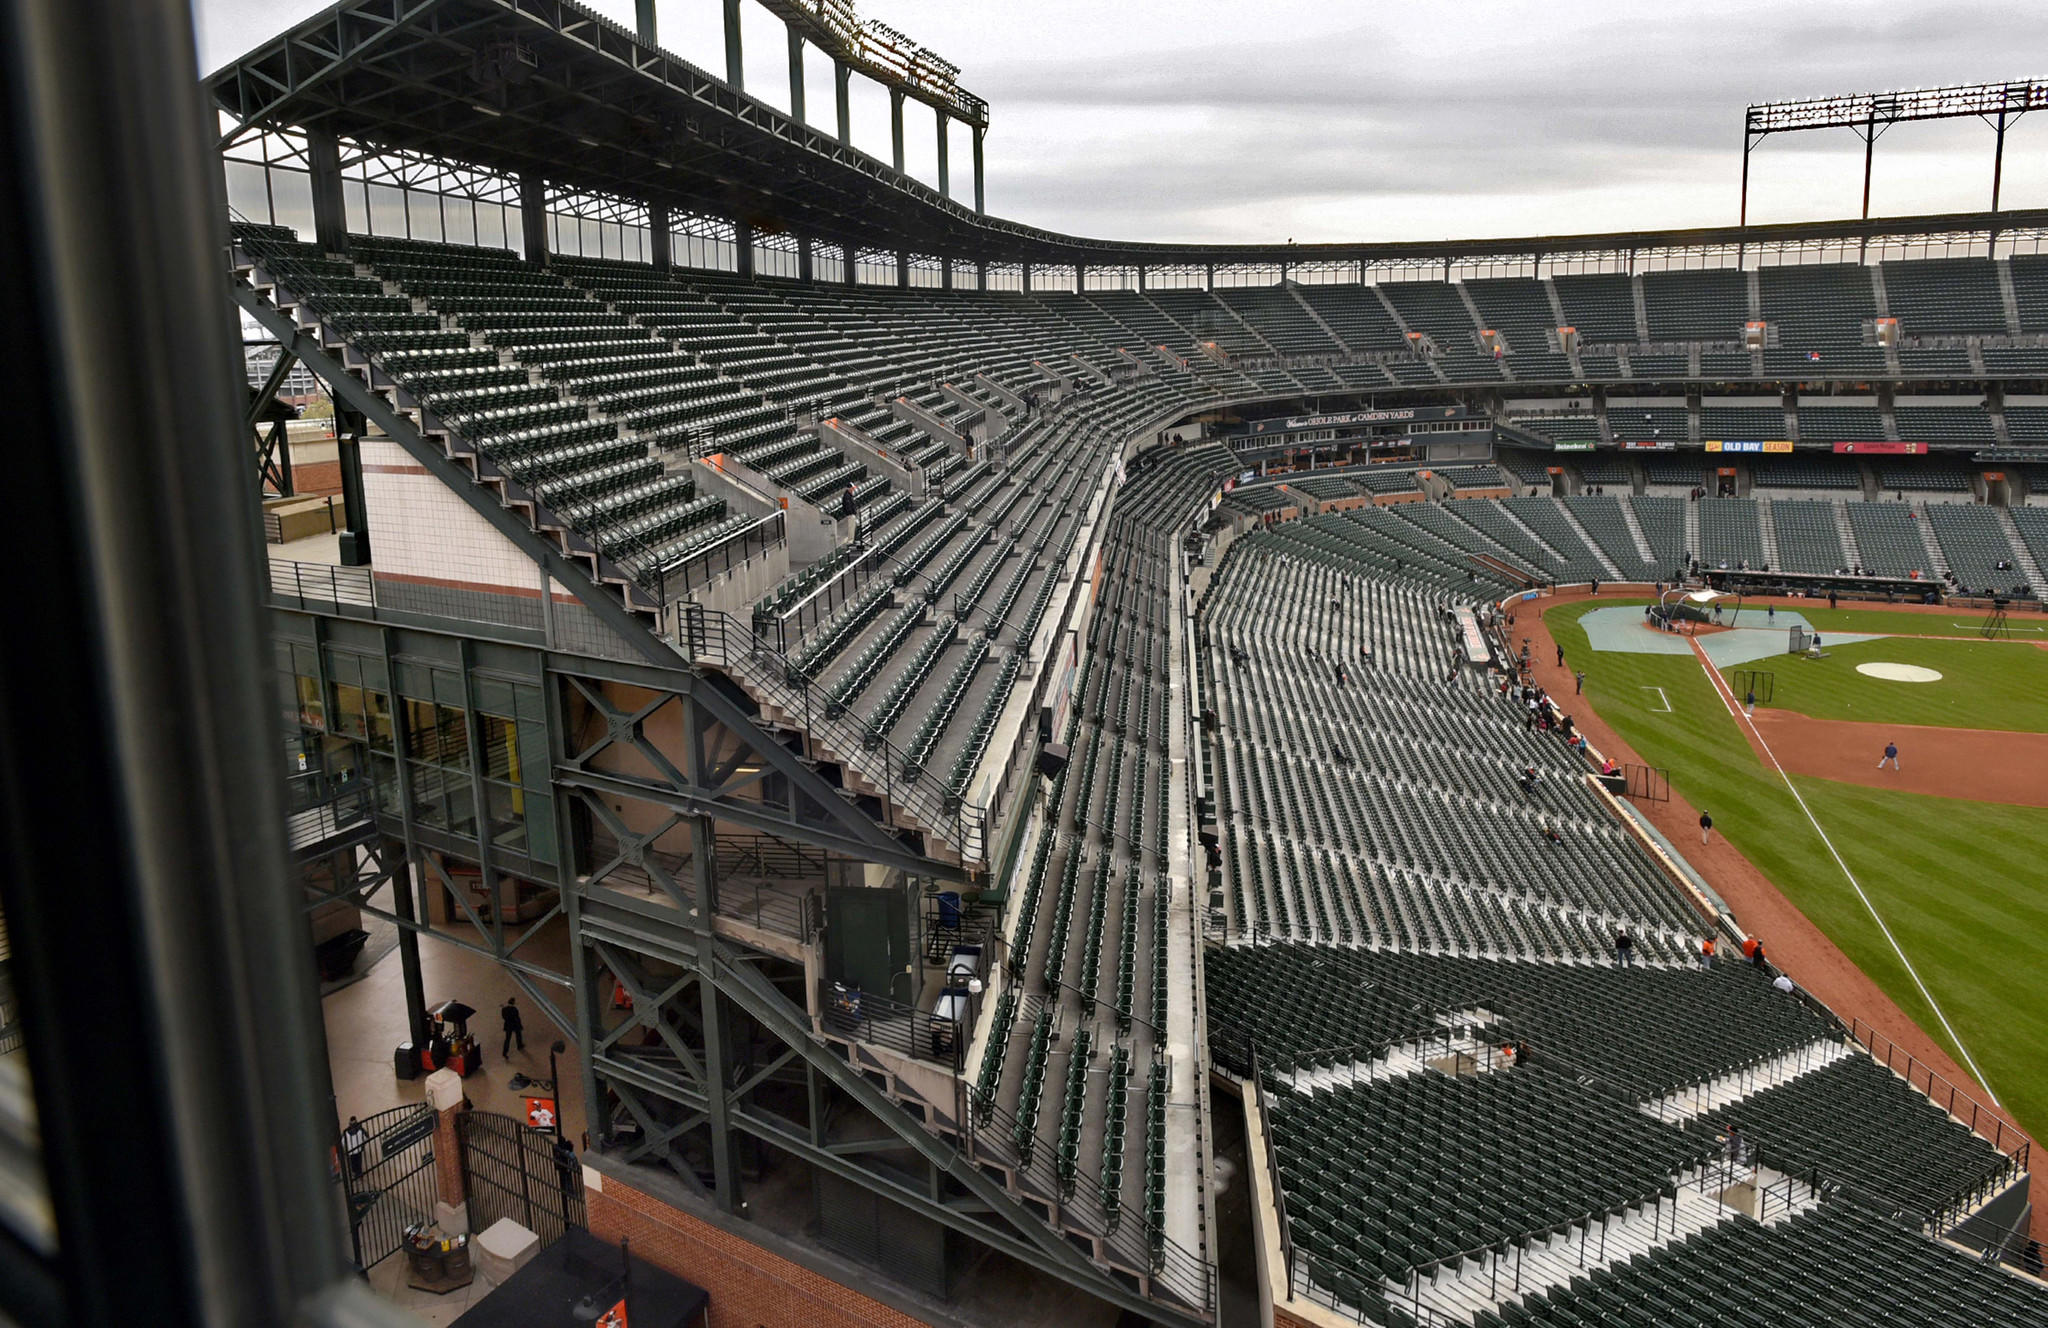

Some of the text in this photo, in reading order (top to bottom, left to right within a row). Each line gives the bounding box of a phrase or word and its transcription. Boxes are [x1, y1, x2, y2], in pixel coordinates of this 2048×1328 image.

[1333, 414, 1352, 424] PARK
[1357, 411, 1389, 422] CAMDEN
[1389, 410, 1415, 420] YARDS
[1724, 442, 1741, 451] OLD
[1743, 442, 1760, 451] BAY
[1765, 442, 1790, 451] SEASON
